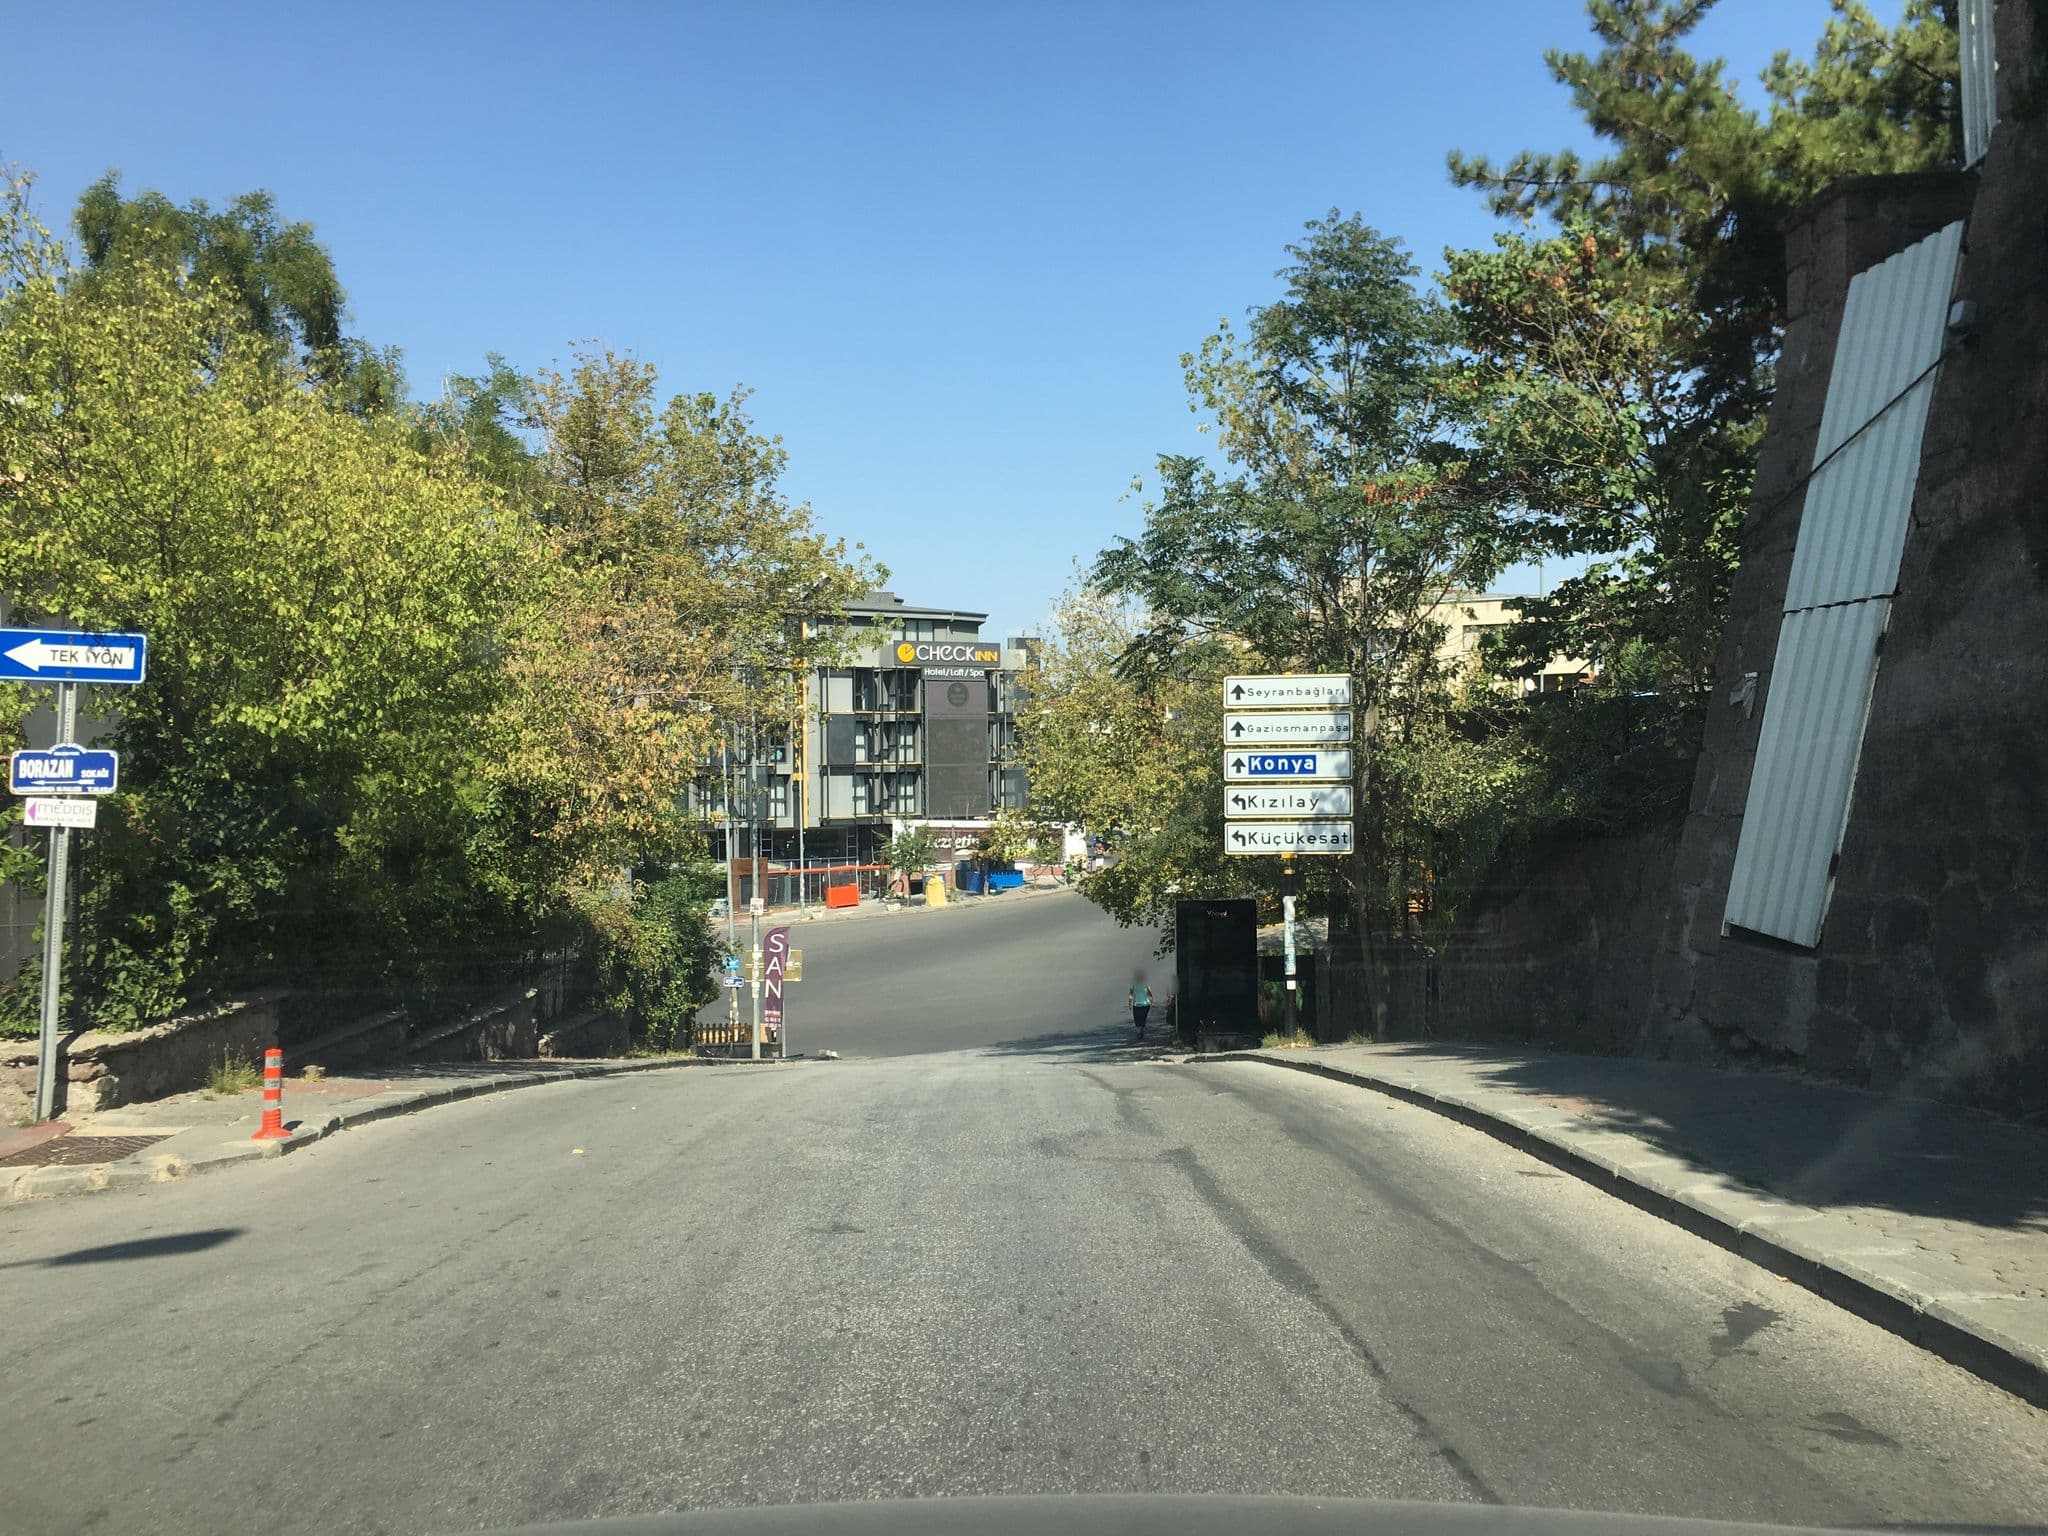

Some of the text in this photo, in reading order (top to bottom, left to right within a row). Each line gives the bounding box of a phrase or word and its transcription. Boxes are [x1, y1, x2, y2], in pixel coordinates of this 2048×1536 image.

[50, 649, 123, 665] TEK YÖN
[1247, 687, 1345, 698] Seyranbağları
[1247, 724, 1349, 734] Gaziosmanpaşa
[19, 759, 74, 778] BORAZAN
[1250, 757, 1315, 773] Konya
[1248, 795, 1319, 811] Kızılay
[1248, 830, 1349, 845] Küçükesat
